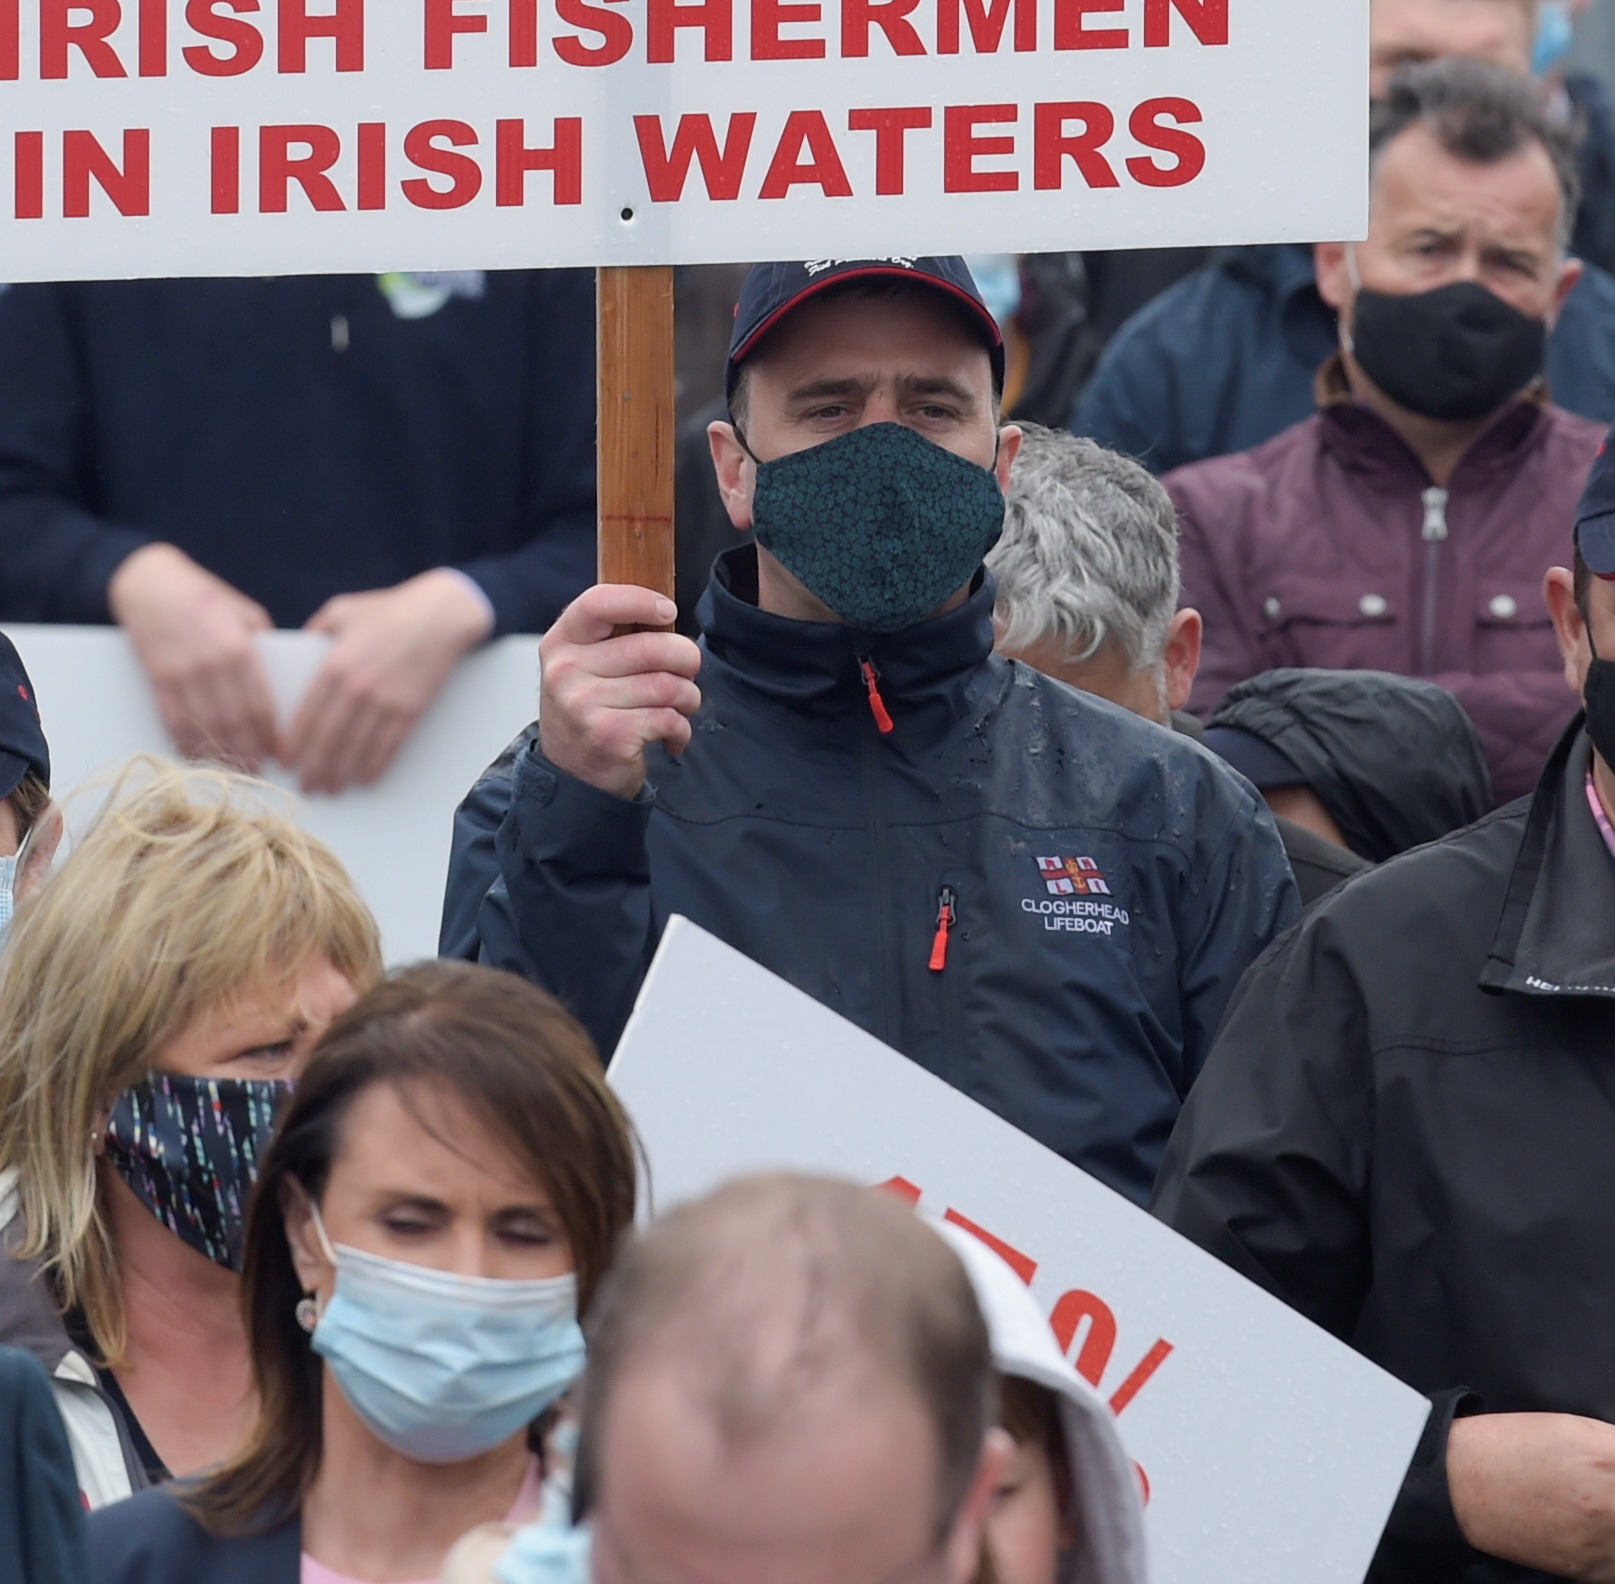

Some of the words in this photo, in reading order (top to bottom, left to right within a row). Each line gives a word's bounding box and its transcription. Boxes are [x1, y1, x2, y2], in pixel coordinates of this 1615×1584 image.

[15, 128, 150, 219] IN
[211, 117, 583, 215] IRISH
[634, 96, 1206, 203] WATERS
[1021, 898, 1130, 925] CLOGHERHEAD
[1044, 916, 1114, 935] LIFEBOAT
